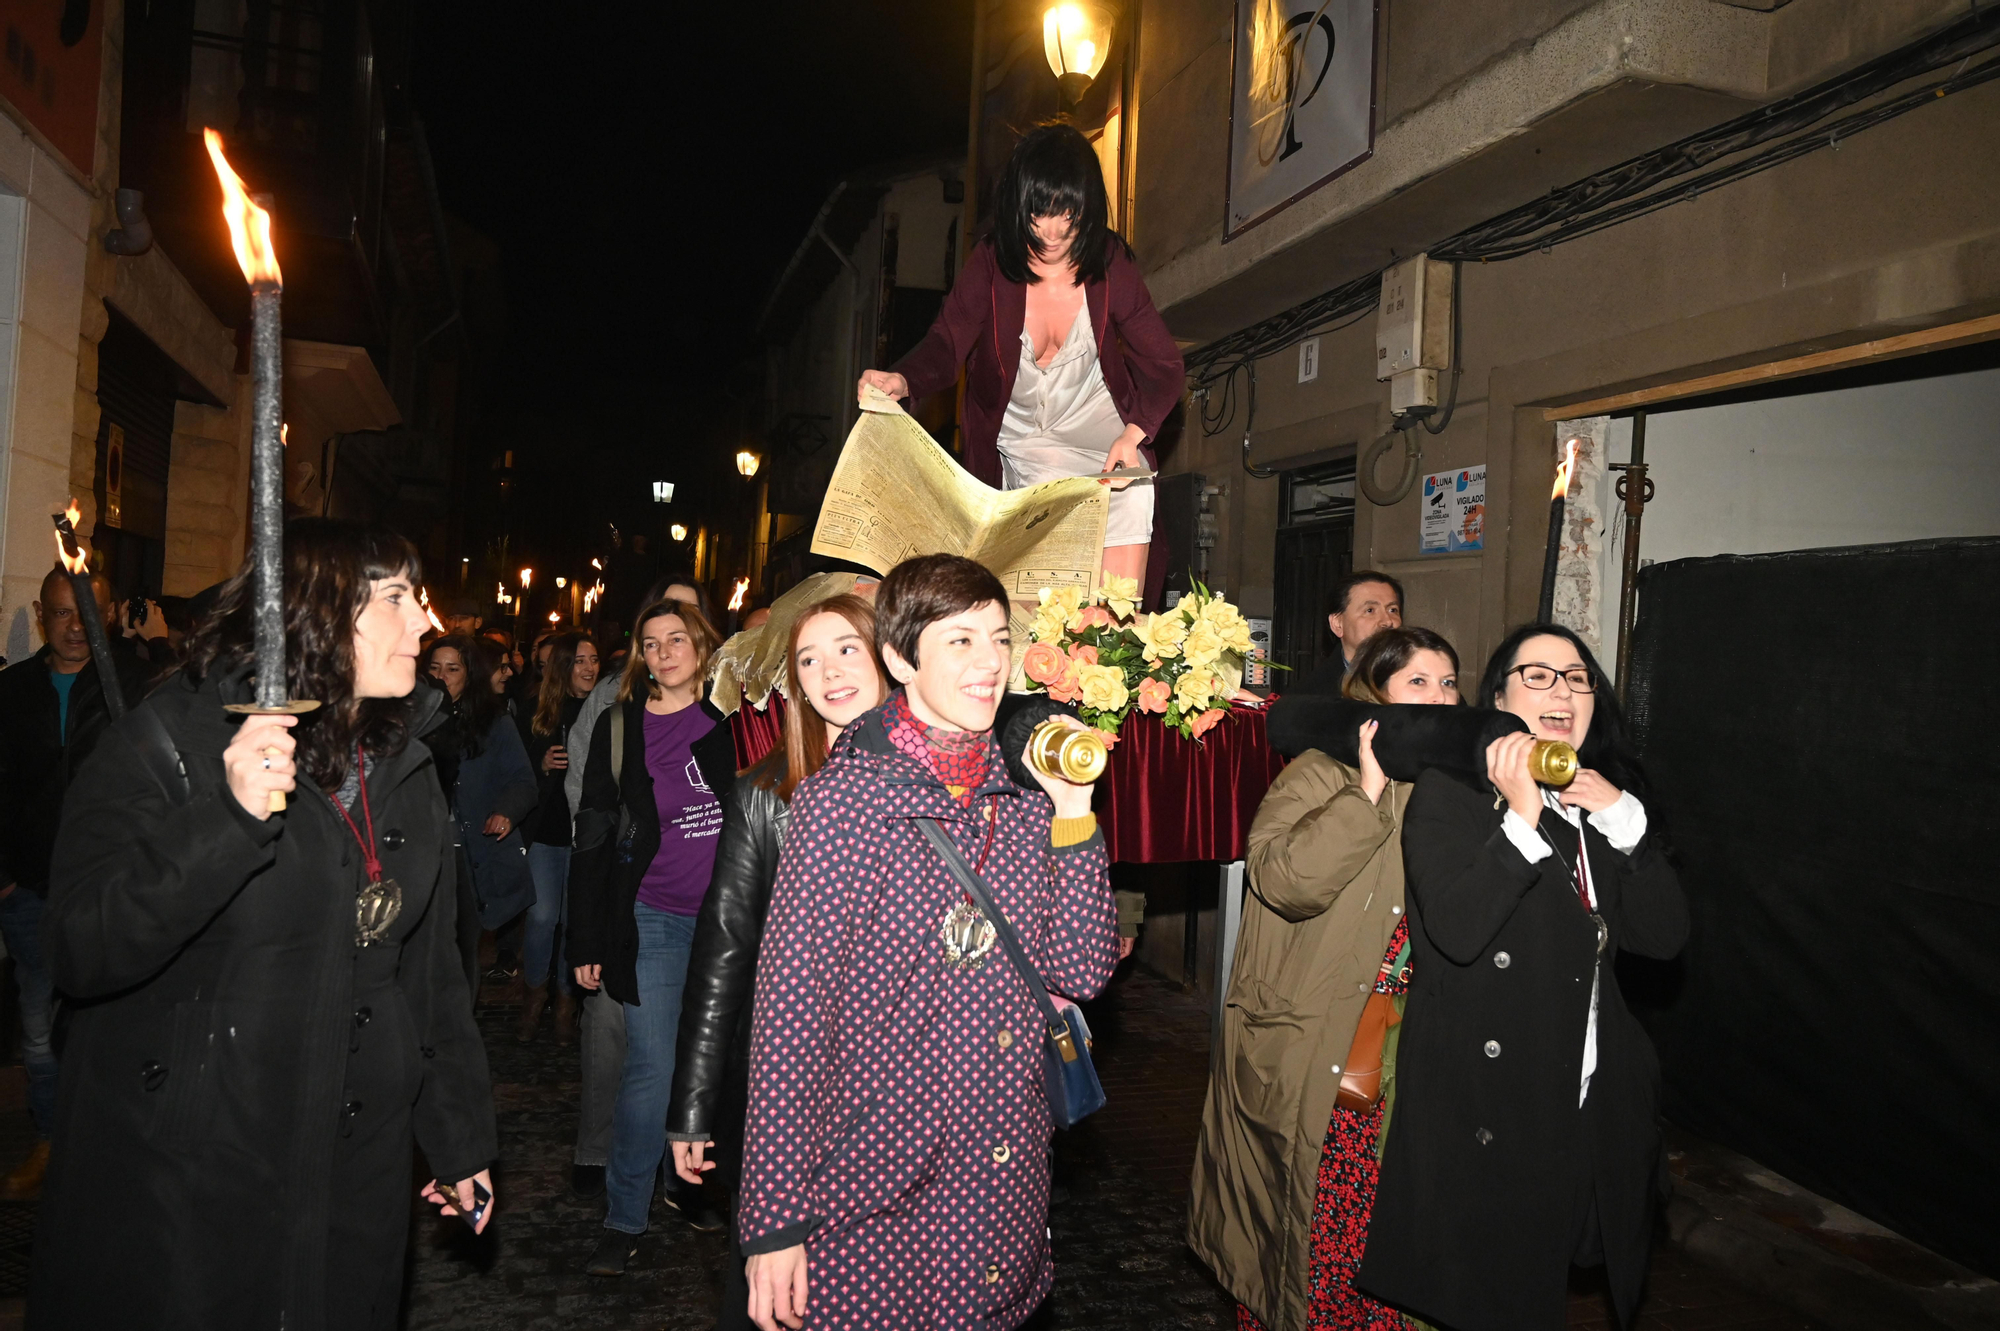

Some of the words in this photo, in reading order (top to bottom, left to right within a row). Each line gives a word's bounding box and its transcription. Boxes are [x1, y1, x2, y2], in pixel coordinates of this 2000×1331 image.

[1304, 344, 1313, 376] 6
[1436, 477, 1452, 486] LUNA
[1469, 472, 1486, 482] LUNA
[1457, 494, 1484, 505] VIGILADO
[1464, 505, 1477, 515] 24H
[685, 812, 703, 822] junto
[684, 830, 692, 839] el
[692, 827, 721, 837] mercader
